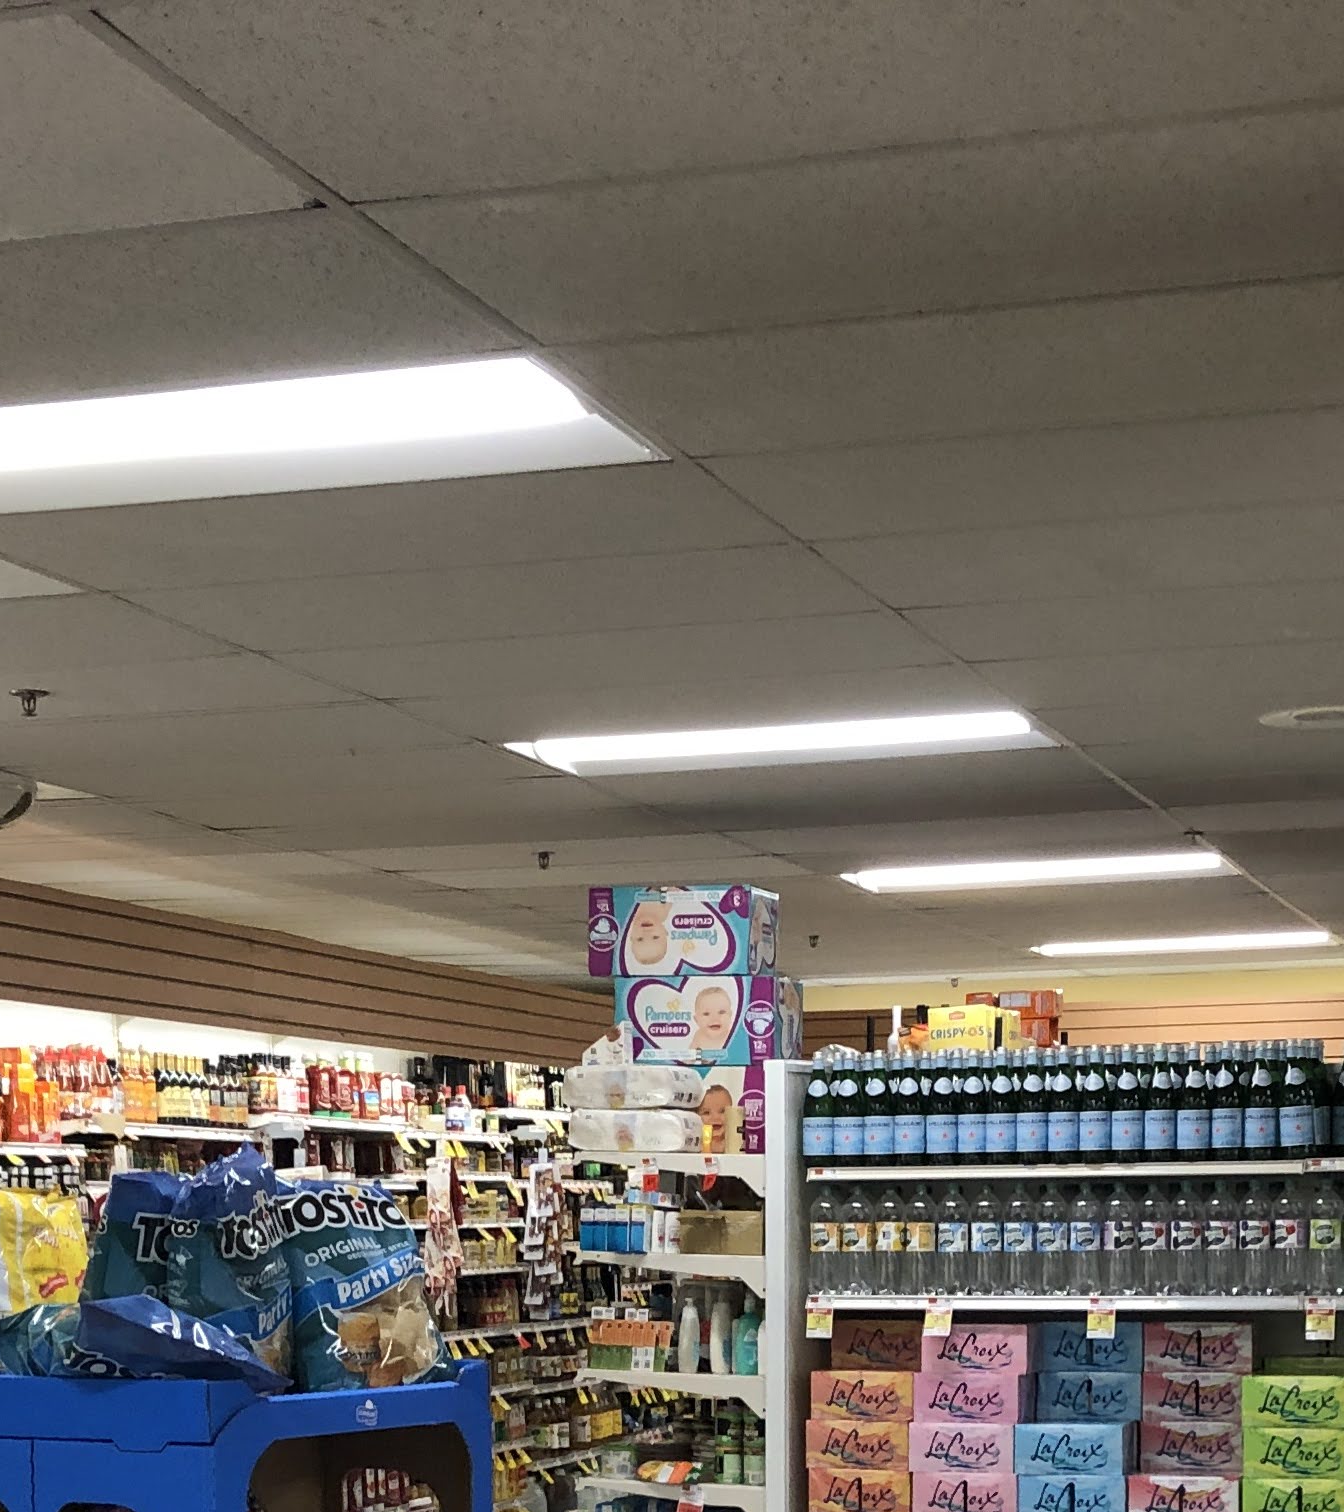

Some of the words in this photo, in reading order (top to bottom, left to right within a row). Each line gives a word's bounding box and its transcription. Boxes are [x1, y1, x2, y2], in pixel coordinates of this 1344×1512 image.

[671, 929, 718, 946] Pampers
[645, 1006, 692, 1023] Pampers
[304, 1235, 382, 1267] ORIGINAL
[337, 1265, 390, 1305] Party
[938, 1333, 1009, 1360] LaCroix
[828, 1380, 895, 1406] LaCroix
[930, 1377, 999, 1407] LaCroix
[1260, 1386, 1335, 1413] LaCroix
[822, 1425, 891, 1456] LaCroix
[926, 1433, 995, 1459] LaCroix
[1033, 1435, 1103, 1462] LaCroix
[1159, 1431, 1227, 1459] LaCroix
[1261, 1437, 1336, 1465] LaCroix
